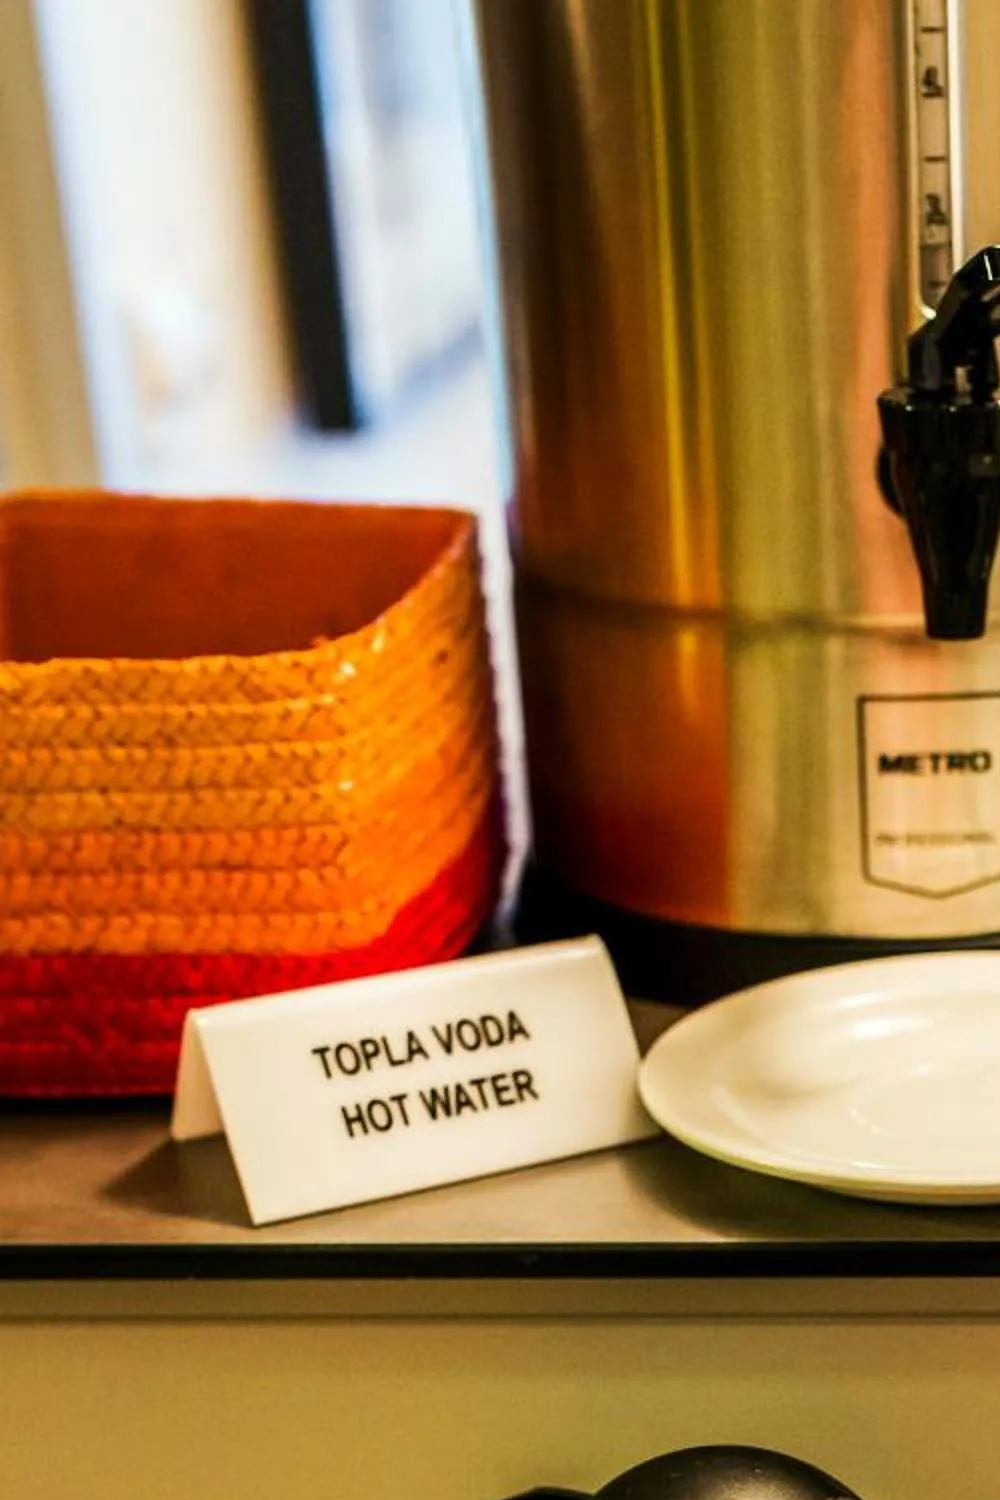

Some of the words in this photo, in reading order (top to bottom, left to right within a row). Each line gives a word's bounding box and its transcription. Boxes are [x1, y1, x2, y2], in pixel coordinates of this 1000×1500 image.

[877, 750, 992, 774] METRO
[311, 1031, 429, 1079] TOPLA
[431, 1010, 530, 1055] VODA
[341, 1093, 410, 1138] HOT
[419, 1069, 539, 1121] WATER
